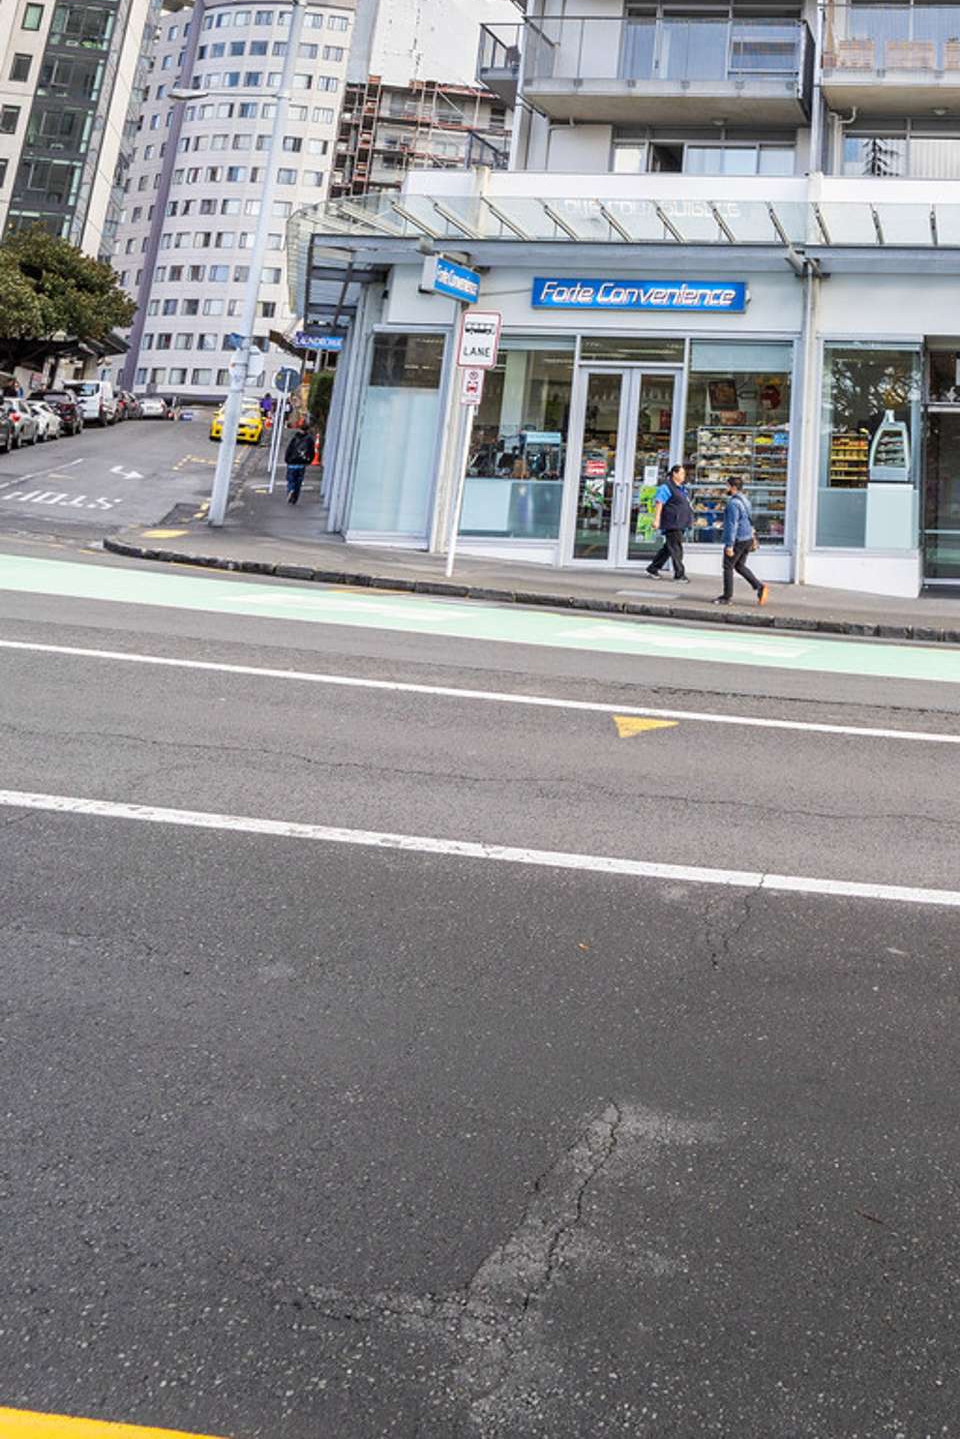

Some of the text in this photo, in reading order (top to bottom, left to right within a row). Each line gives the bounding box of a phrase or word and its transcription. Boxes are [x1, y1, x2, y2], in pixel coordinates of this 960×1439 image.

[540, 281, 736, 306] Forte Convenience
[463, 347, 491, 357] LANE
